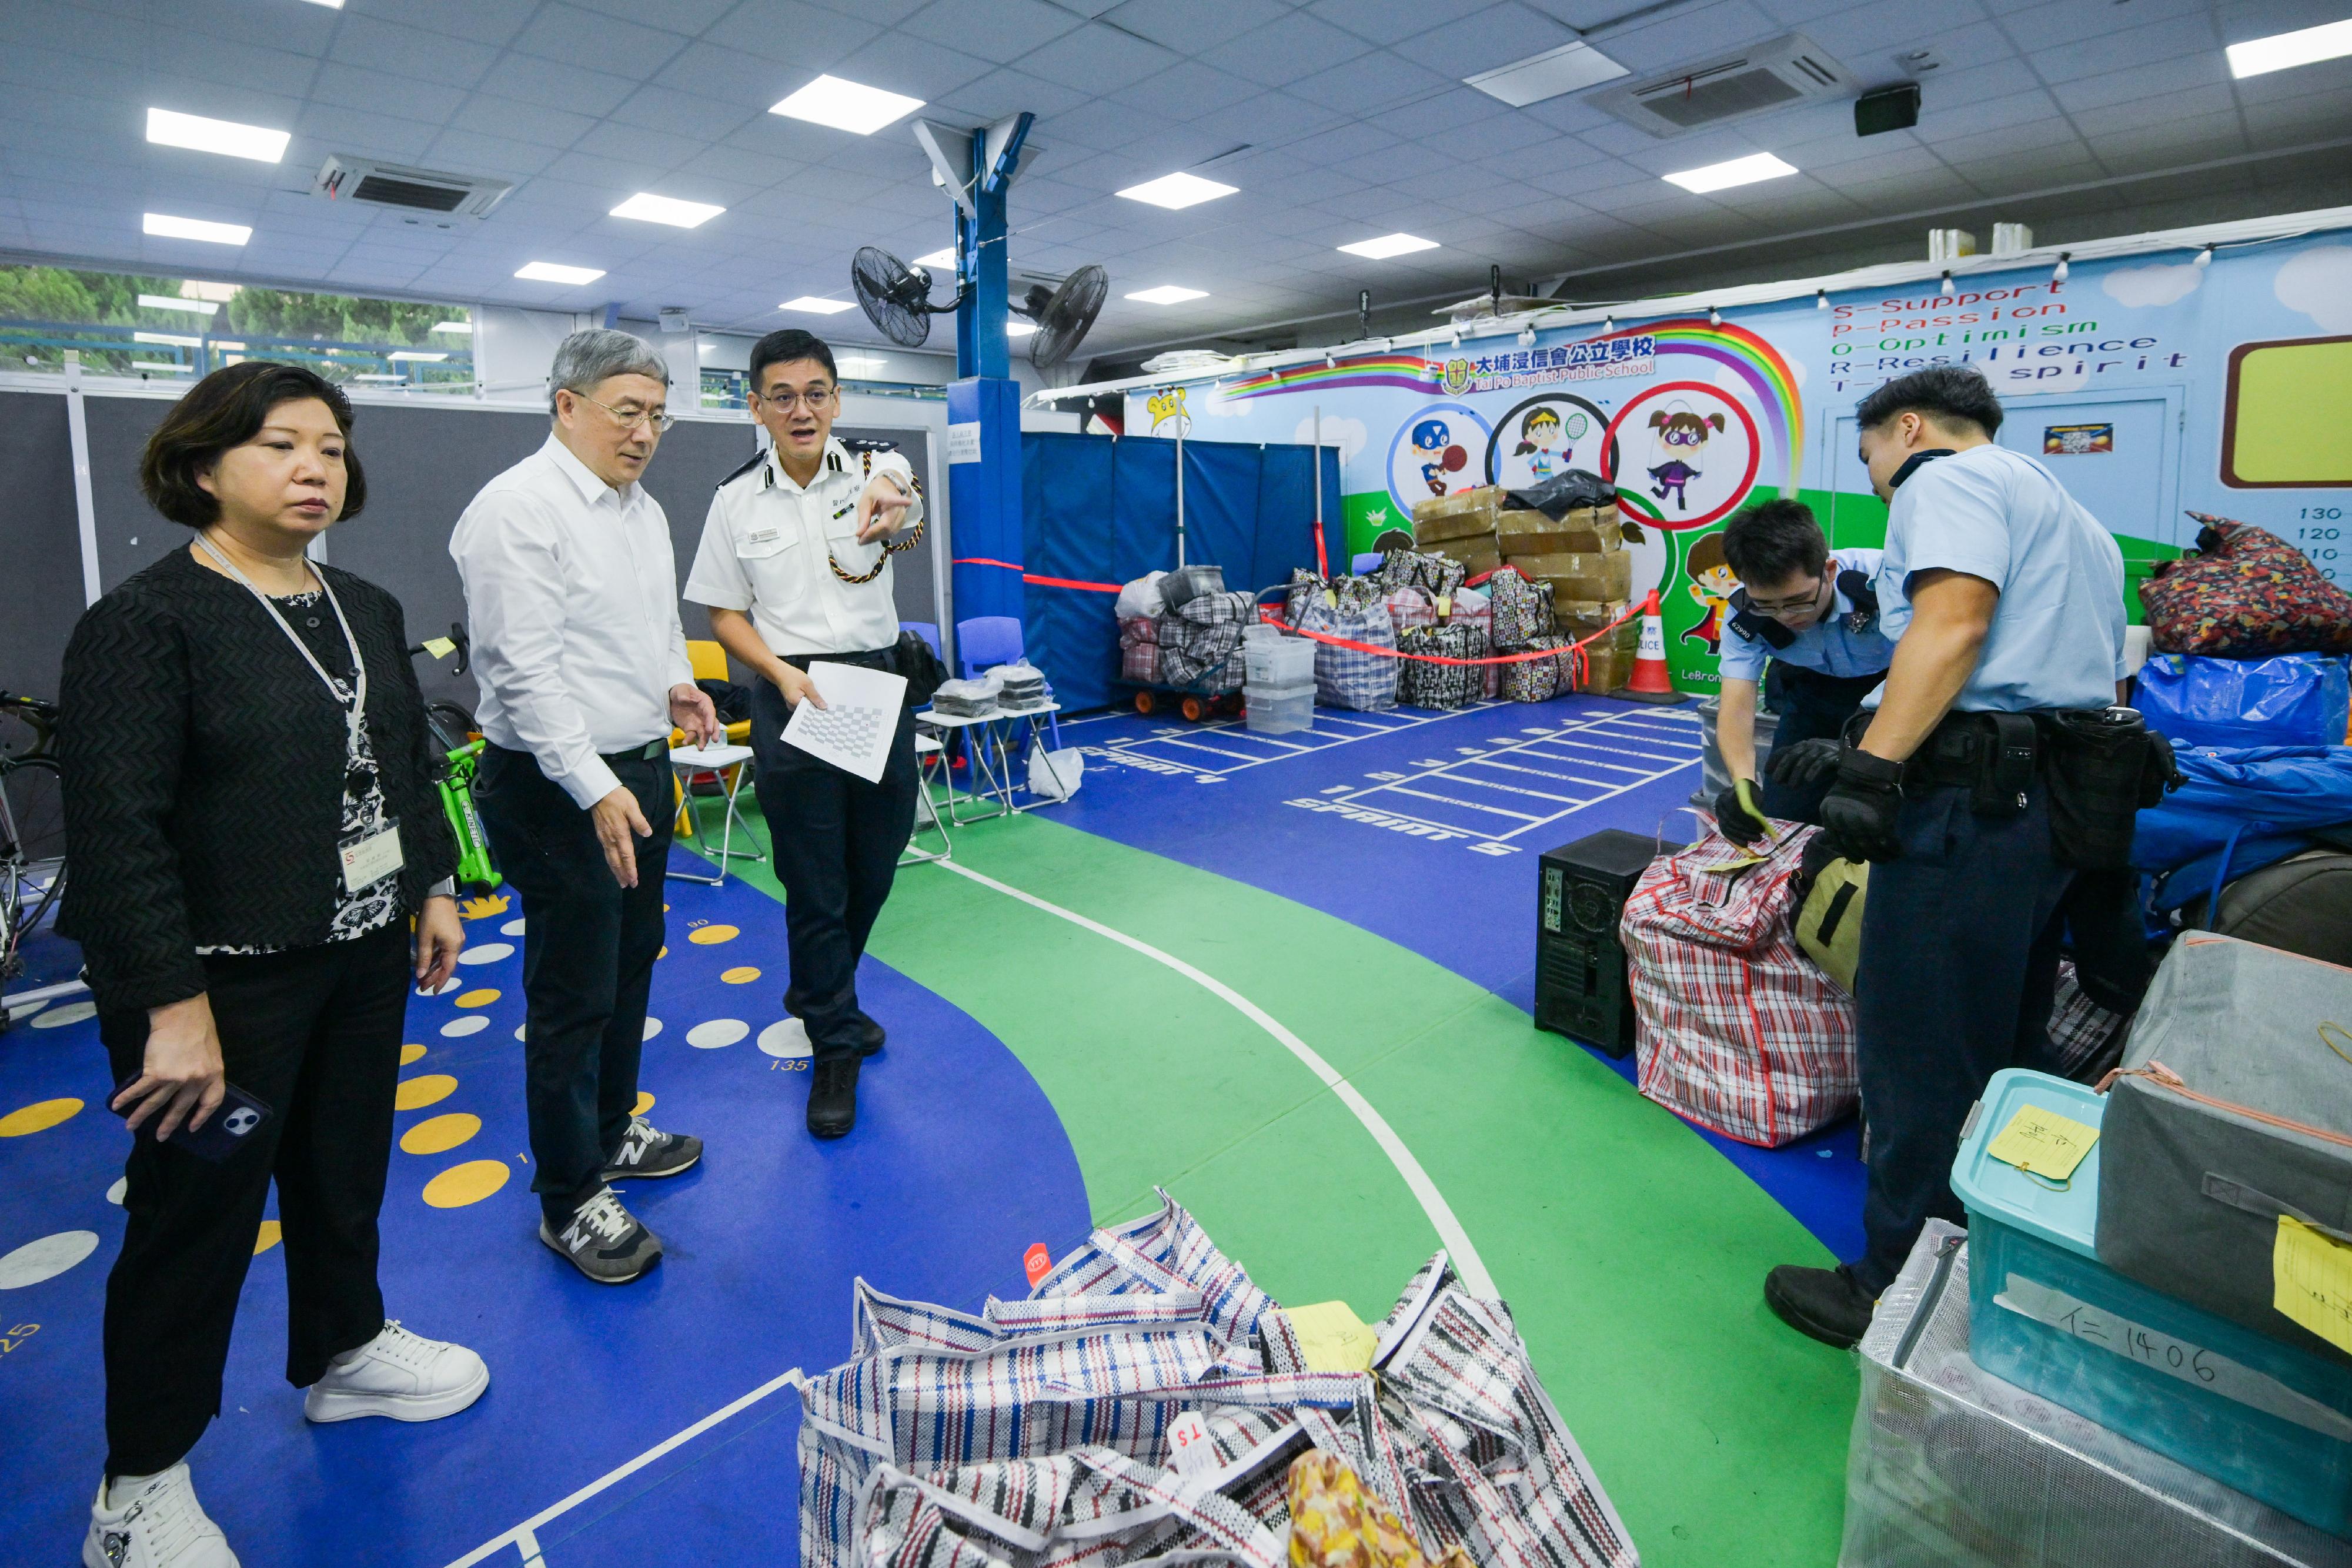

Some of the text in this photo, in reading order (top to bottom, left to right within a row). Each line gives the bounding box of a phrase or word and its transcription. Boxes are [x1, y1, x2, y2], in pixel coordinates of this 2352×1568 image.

[1476, 336, 1653, 375] 大埔浸信會公立學校
[2010, 353, 2187, 379] spirit
[1476, 378, 1492, 390] Tai
[1496, 377, 1511, 389] Po
[1513, 372, 1558, 387] Baptist
[1560, 367, 1604, 381] Public
[1605, 360, 1653, 377] School
[2300, 508, 2342, 520] 130
[2298, 528, 2340, 540] 120
[2299, 548, 2338, 560] 10
[1731, 621, 1751, 639] 62990
[466, 813, 480, 845] KINETIC
[1281, 798, 1469, 841] SPRINT
[770, 1059, 810, 1071] 135
[615, 1141, 647, 1165] N
[560, 1226, 592, 1253] N
[2126, 1327, 2215, 1382] 1406
